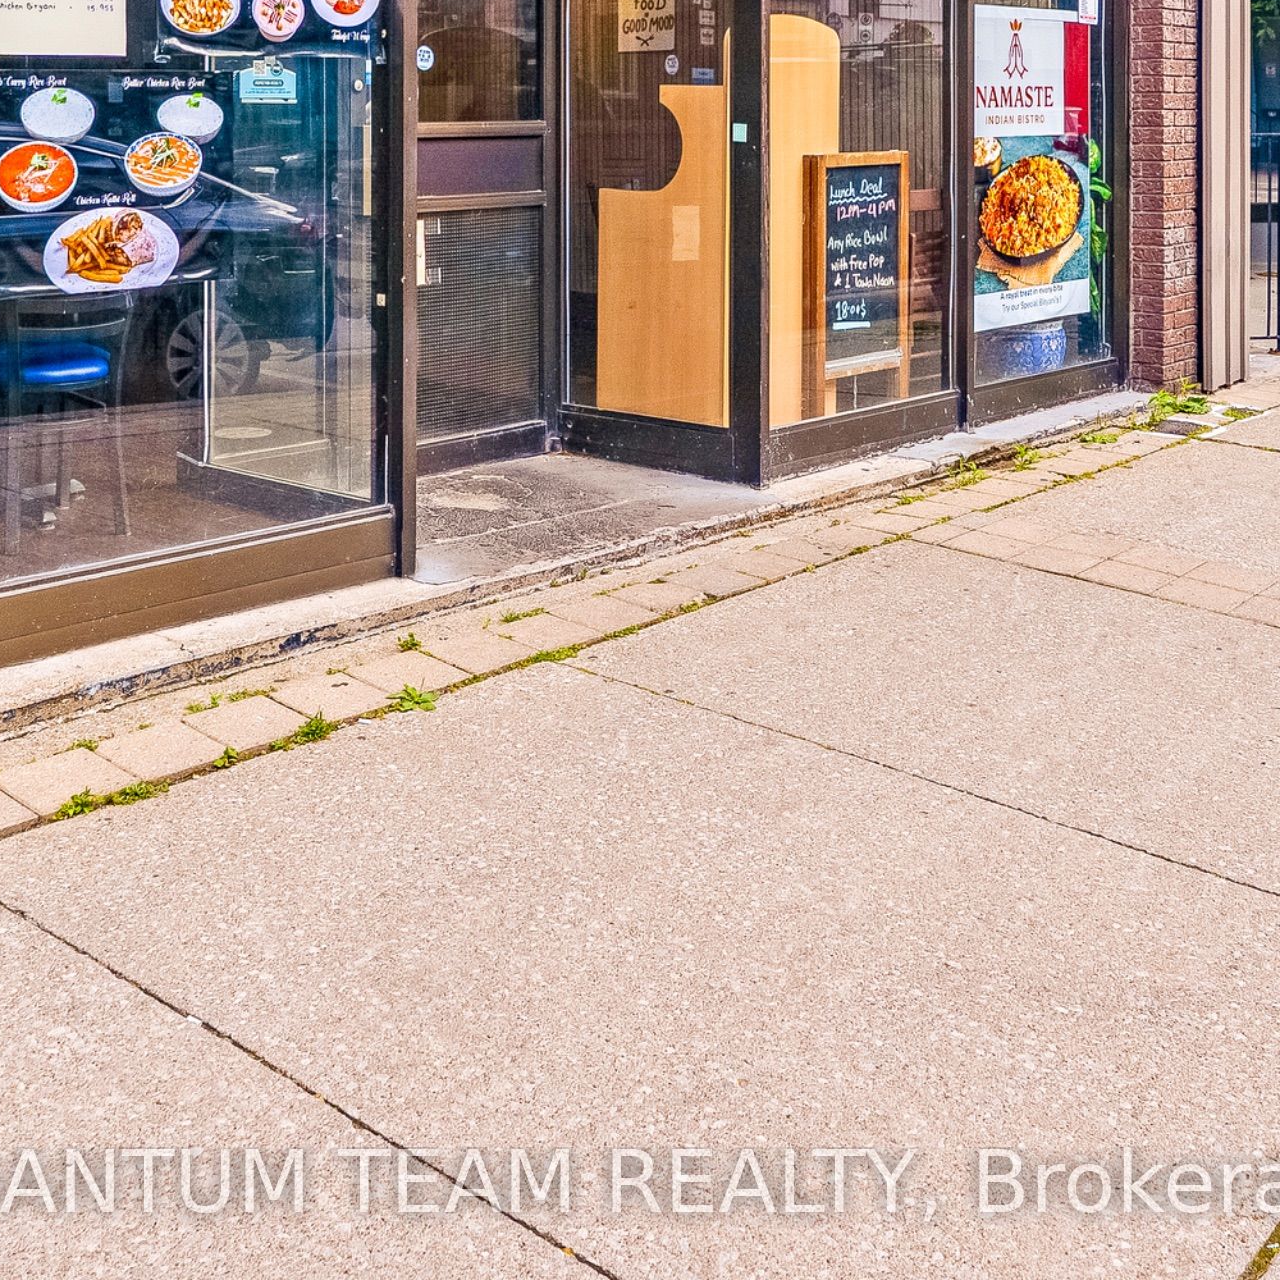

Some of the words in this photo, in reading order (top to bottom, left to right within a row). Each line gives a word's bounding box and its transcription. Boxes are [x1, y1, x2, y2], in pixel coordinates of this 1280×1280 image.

[622, 18, 648, 34] GOOD
[648, 14, 674, 33] MOOD
[975, 85, 1055, 109] NAMASTE
[985, 115, 1015, 125] INDIAN
[1017, 114, 1046, 124] BISTRO
[831, 181, 855, 199] Lunch
[860, 176, 883, 194] Deal
[827, 234, 845, 253] Any
[845, 232, 862, 248] Rice
[863, 225, 888, 245] Bowl
[831, 258, 849, 271] with
